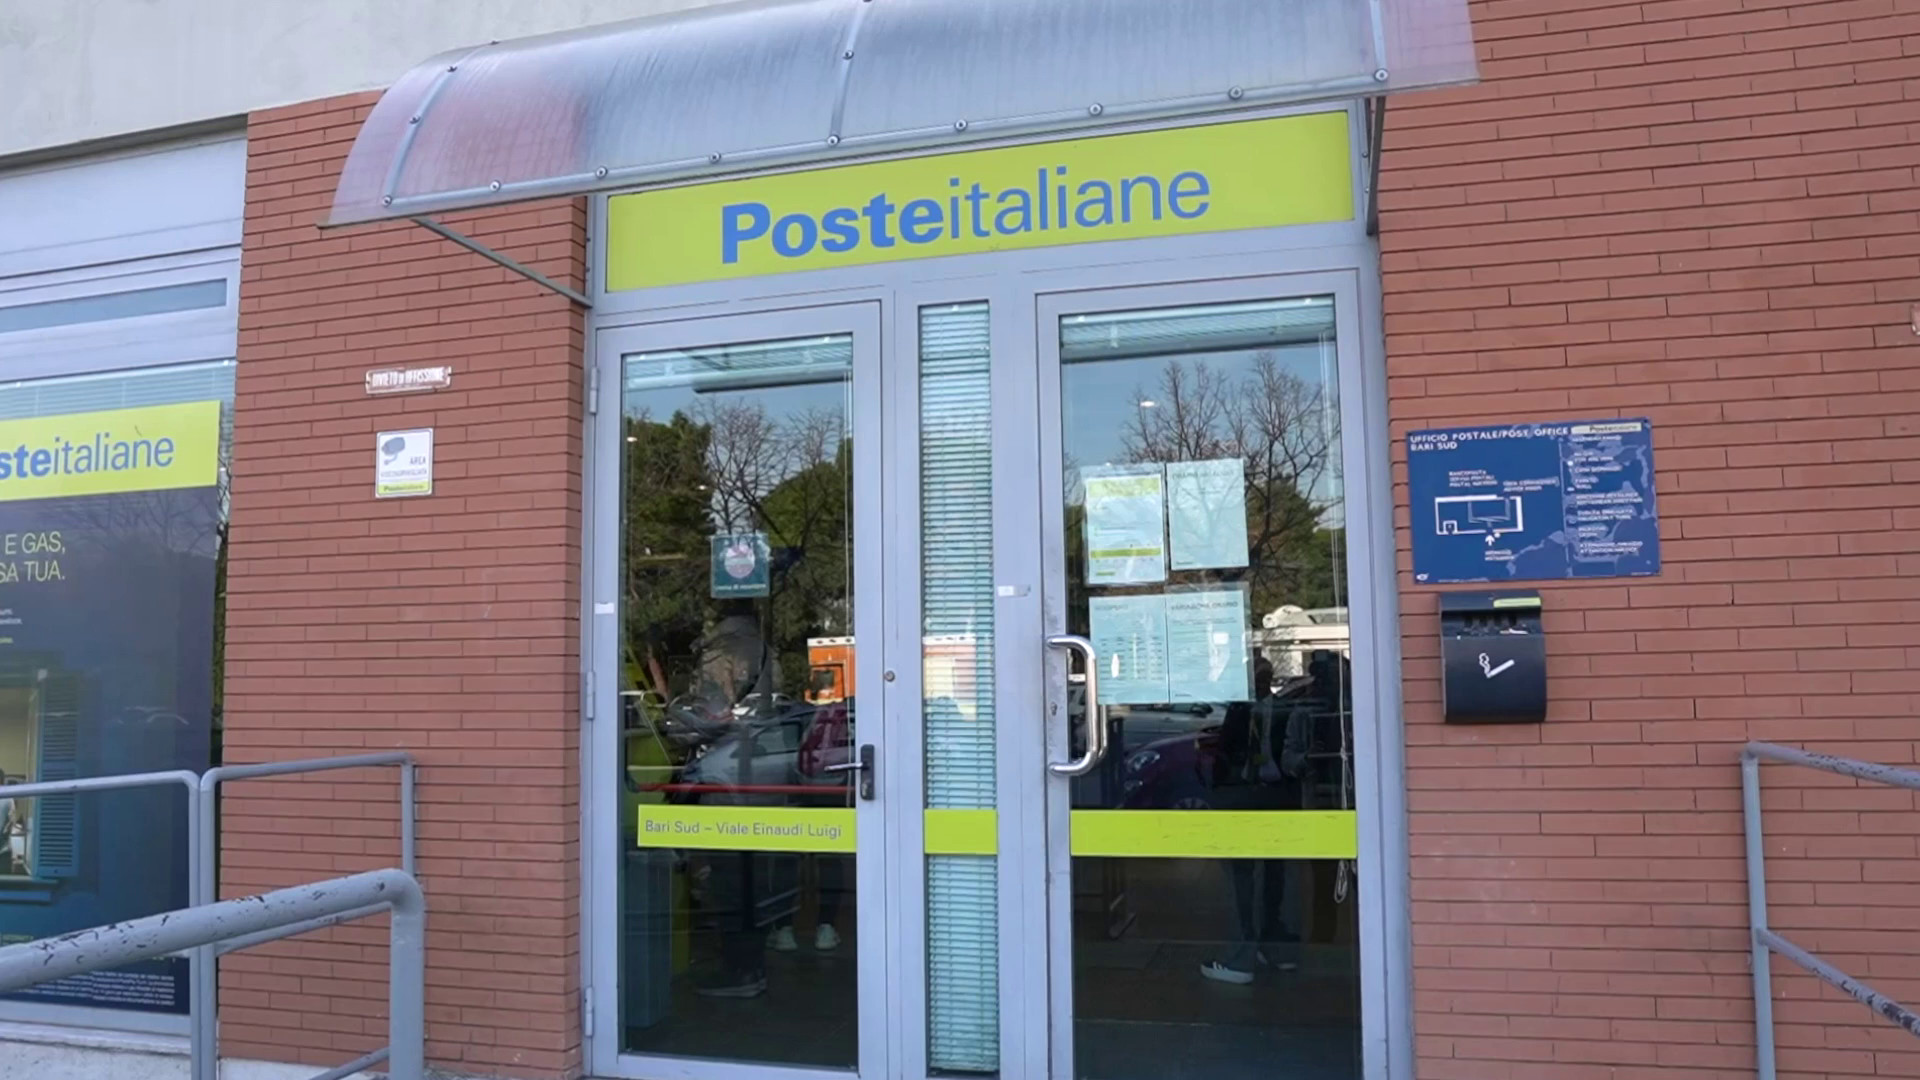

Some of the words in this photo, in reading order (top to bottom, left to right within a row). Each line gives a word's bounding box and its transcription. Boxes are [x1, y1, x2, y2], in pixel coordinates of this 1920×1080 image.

[721, 165, 1211, 264] Posteitaliane
[1410, 433, 1448, 443] UFFICIO
[1534, 427, 1569, 436] OFFICE
[1410, 442, 1434, 451] BARI
[1437, 441, 1458, 450] SUD
[5, 534, 17, 555] E
[22, 531, 66, 555] GAS,
[24, 561, 66, 582] TUA.
[645, 820, 670, 833] Bari
[674, 821, 701, 834] Sud
[716, 822, 749, 835] Viale
[753, 822, 803, 837] Einaudi
[808, 823, 843, 839] Luigi
